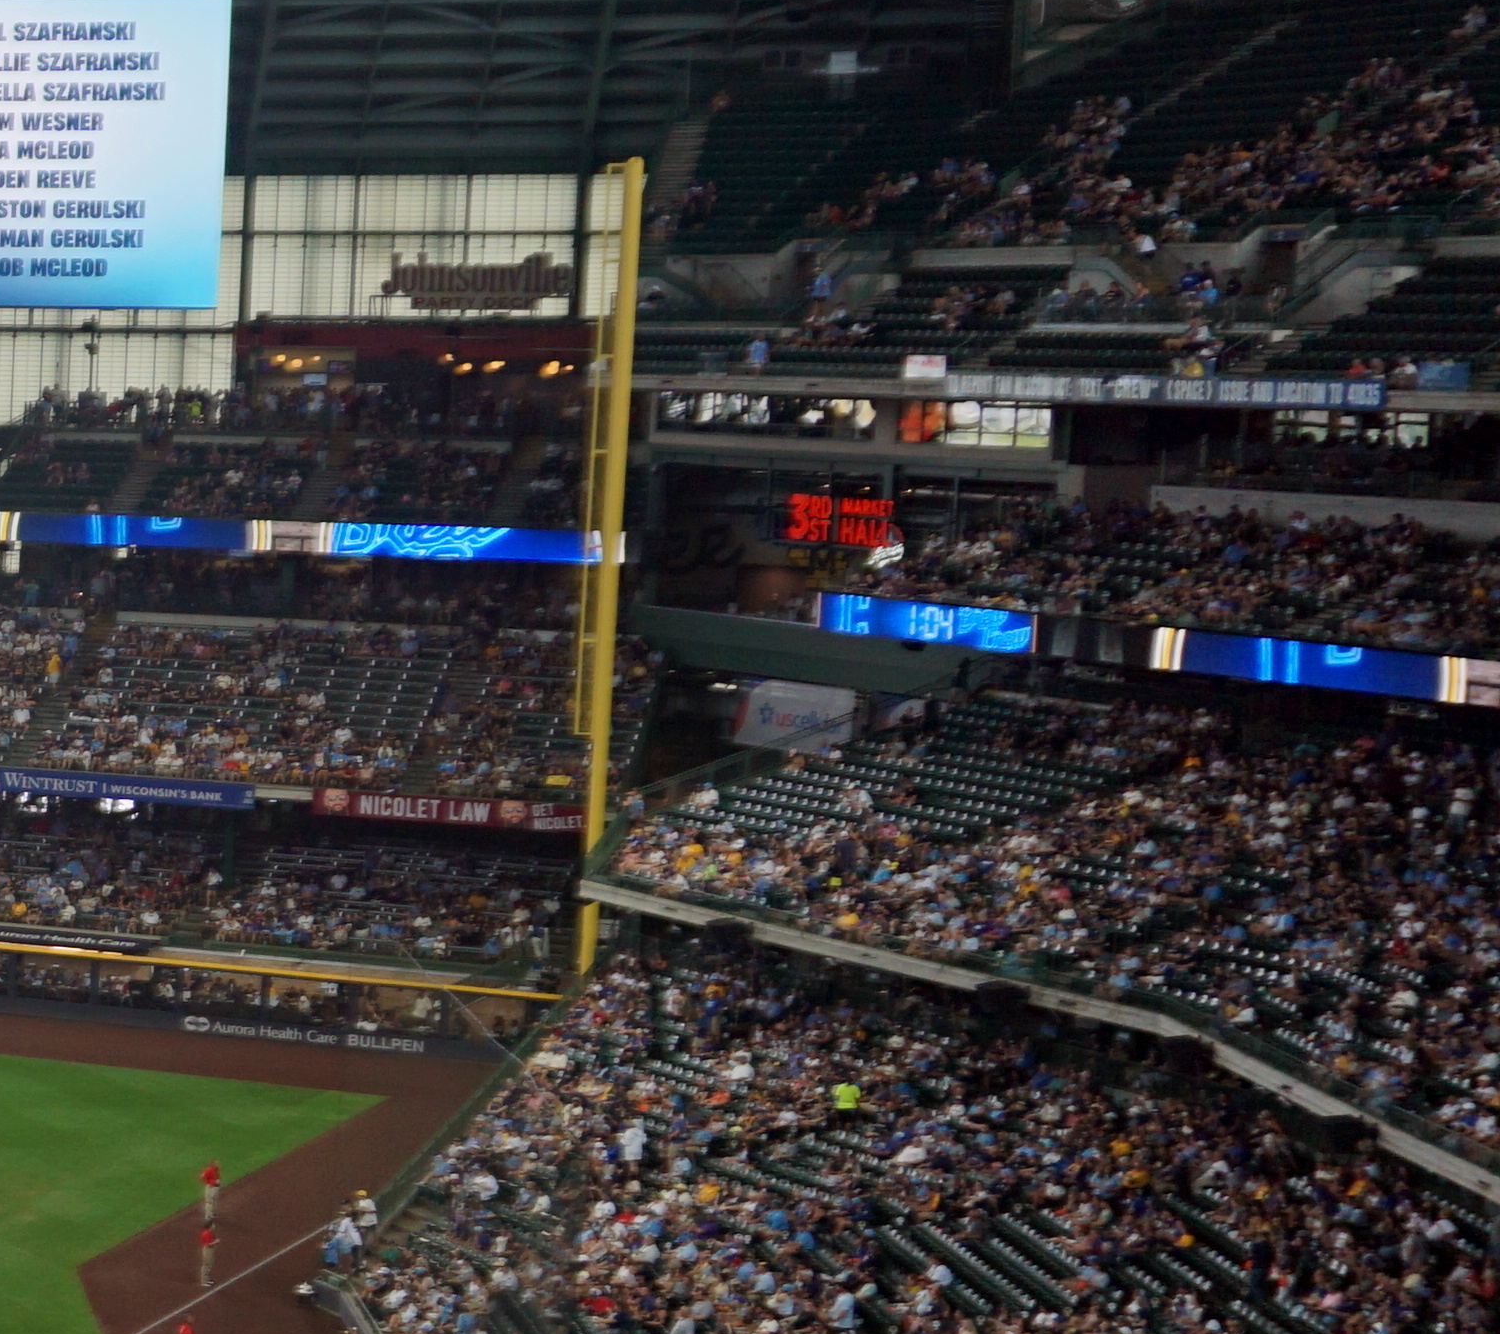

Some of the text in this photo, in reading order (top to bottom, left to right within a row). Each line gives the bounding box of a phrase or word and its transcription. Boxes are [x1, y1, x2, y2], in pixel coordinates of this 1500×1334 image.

[13, 21, 136, 42] SZAFRANSKI
[37, 51, 160, 71] SZAFRANSKI
[42, 80, 166, 101] SZAFRANSKI
[21, 112, 104, 132] WESNER
[16, 141, 95, 161] MCLEOD
[38, 169, 96, 189] REEVE
[52, 198, 146, 220] GERULSKI
[50, 227, 145, 249] GERULSKI
[30, 257, 108, 278] MCLEOD
[382, 251, 574, 295] Johnsonville
[414, 296, 539, 310] PARTY DECK
[839, 497, 895, 517] MARKET
[908, 604, 954, 641] 1:04
[3, 771, 98, 795] WINTRUST
[110, 784, 190, 800] WISCONSIN'S
[191, 789, 223, 802] BANK
[358, 794, 491, 823] NICOLET LAW
[212, 1020, 425, 1054] Aurora Health Care BULLPEN
